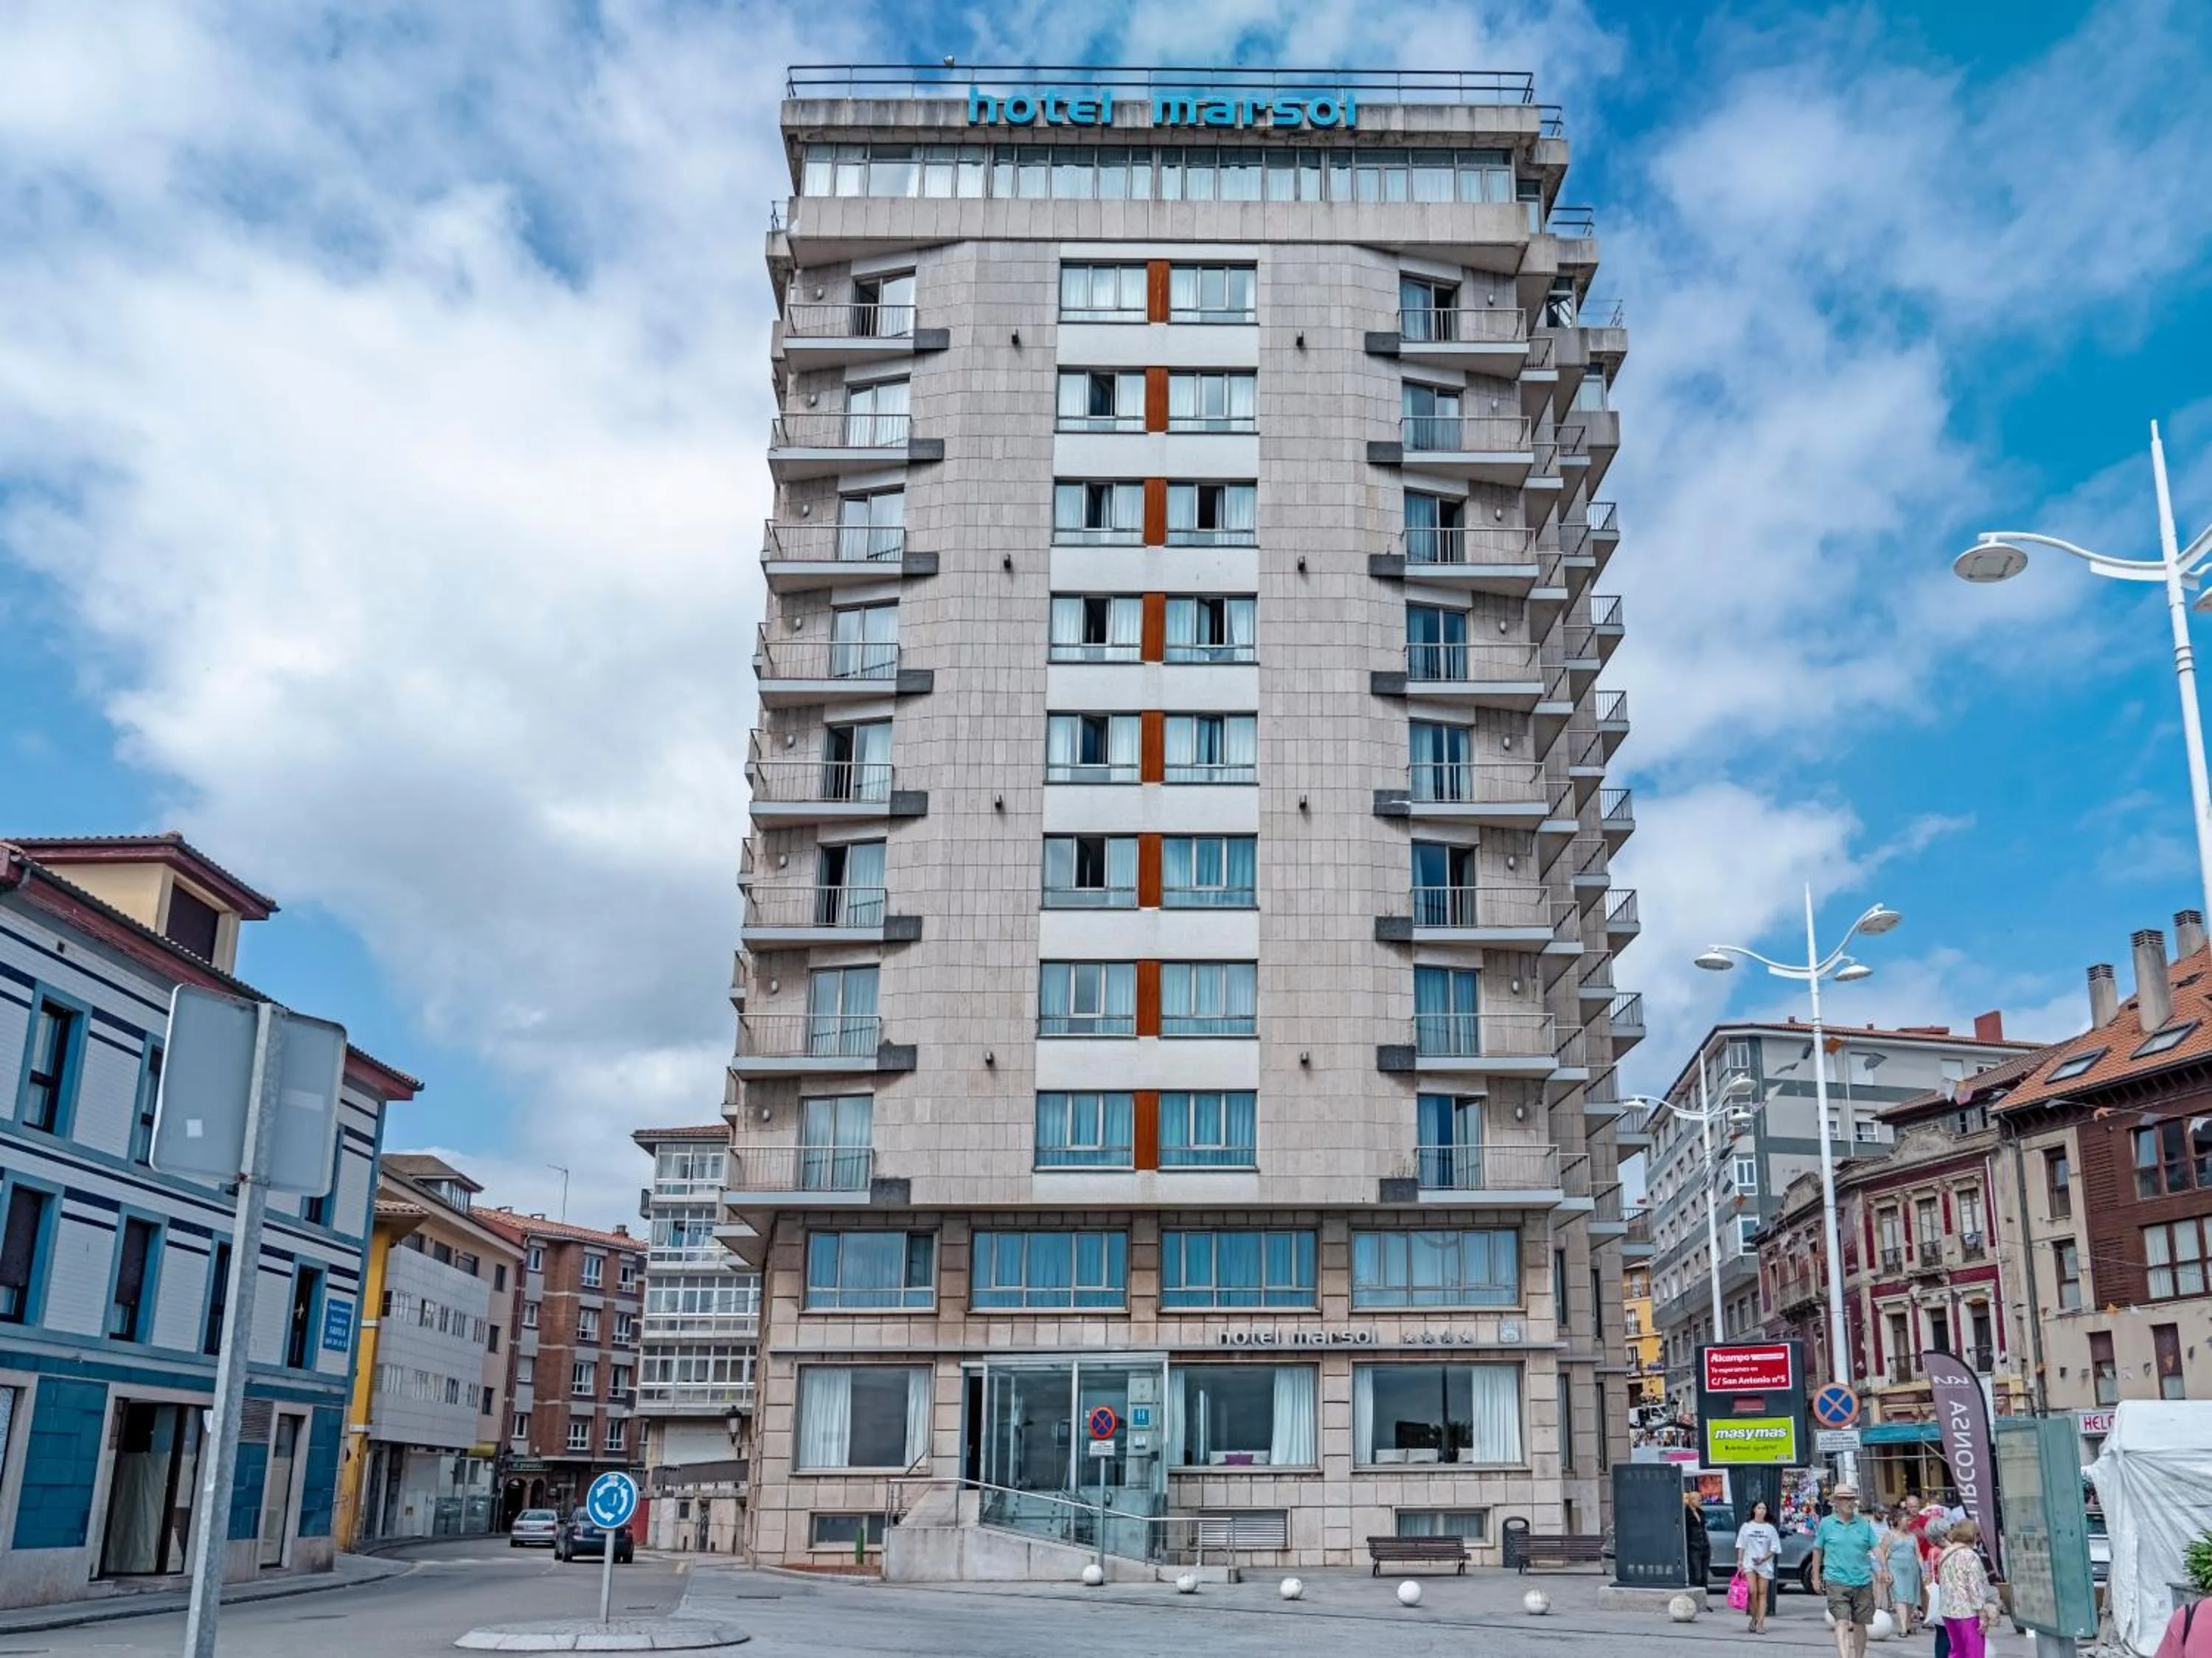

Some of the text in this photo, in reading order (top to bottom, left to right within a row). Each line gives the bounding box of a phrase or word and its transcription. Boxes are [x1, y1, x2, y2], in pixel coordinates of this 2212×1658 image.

[967, 84, 1357, 130] hotel marsol
[1217, 1327, 1379, 1345] hotel marsol
[1711, 1353, 1750, 1363] Alcampo
[1711, 1377, 1721, 1386] C/
[1739, 1376, 1770, 1384] Antonio
